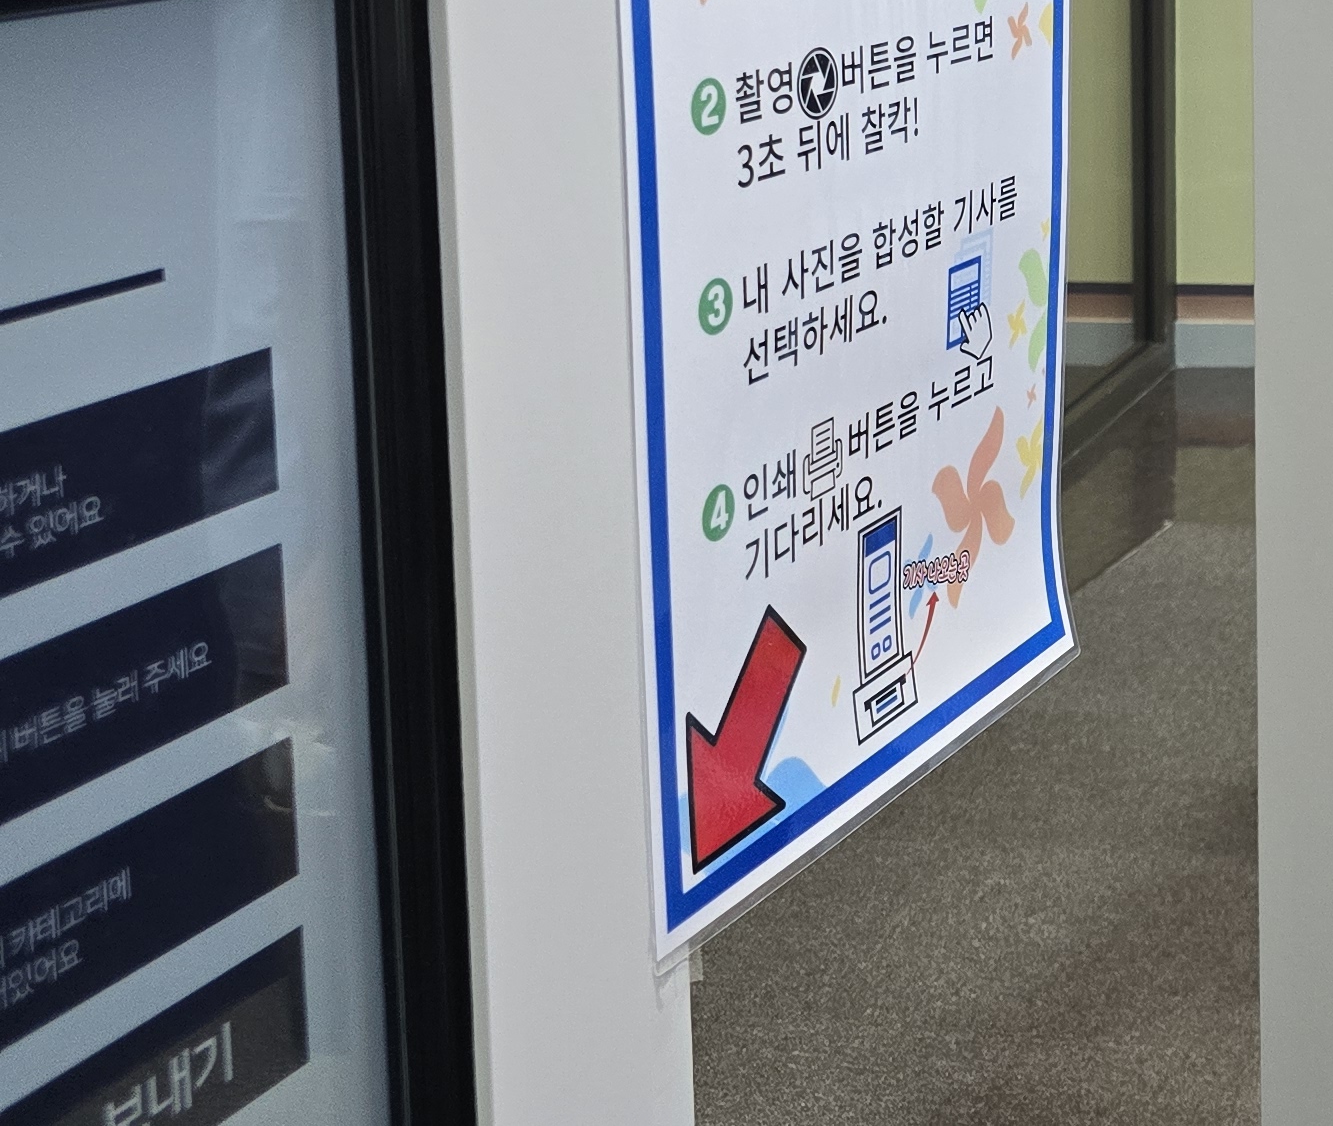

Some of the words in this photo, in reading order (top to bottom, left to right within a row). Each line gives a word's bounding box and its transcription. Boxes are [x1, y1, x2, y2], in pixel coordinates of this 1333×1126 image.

[700, 85, 719, 128] 2
[735, 62, 794, 124] 촬영
[841, 36, 917, 94] 버튼을
[926, 15, 994, 74] 누르면
[737, 134, 786, 188] 3초
[797, 113, 850, 172] 뒤에
[861, 97, 919, 155] 찰칵!
[708, 285, 726, 327] 3
[742, 263, 769, 314] 내
[782, 232, 862, 300] 사진을
[872, 200, 945, 269] 합성할
[953, 175, 1018, 235] 기사를
[743, 290, 888, 385] 선택하세요.
[710, 489, 730, 531] 4
[743, 449, 797, 521] 인쇄
[848, 391, 920, 459] 버튼을
[928, 355, 994, 422] 누르고
[745, 476, 883, 580] 기다리세요.
[903, 558, 928, 590] 기사
[927, 552, 959, 585] 나오는
[11, 694, 88, 751] 버튼을
[142, 641, 212, 694] 주세요
[9, 866, 132, 955] 카테고리에
